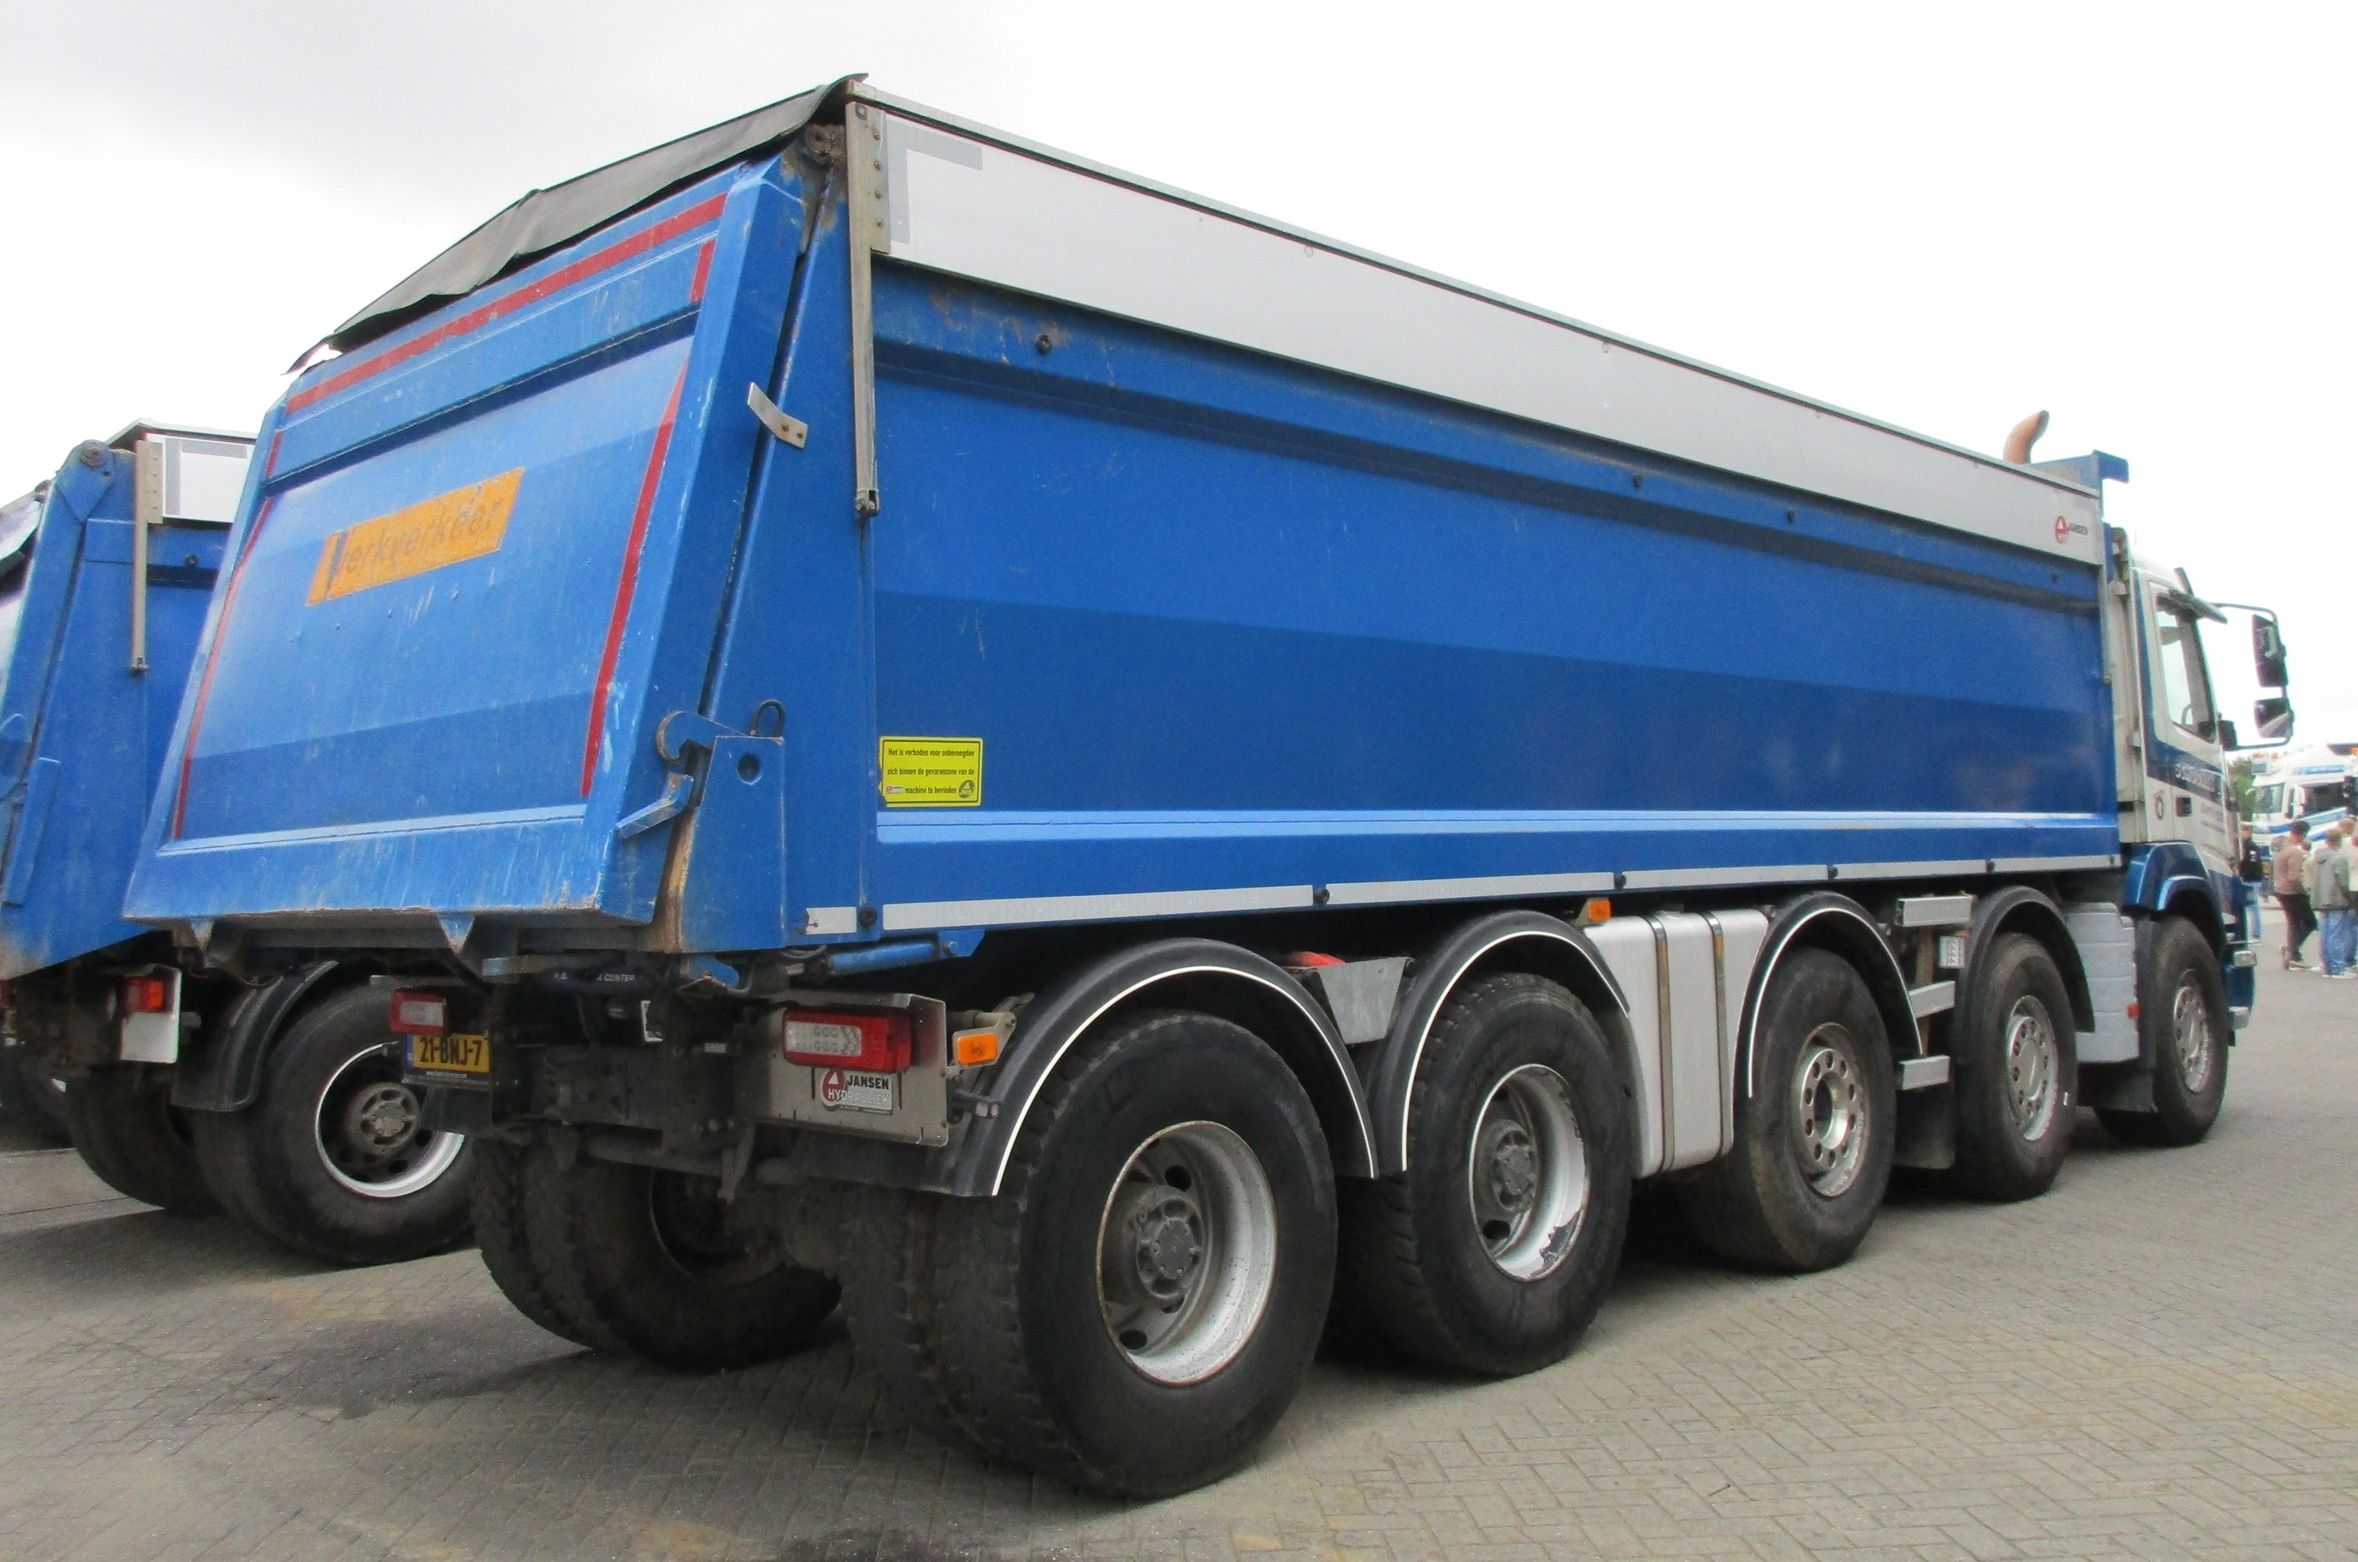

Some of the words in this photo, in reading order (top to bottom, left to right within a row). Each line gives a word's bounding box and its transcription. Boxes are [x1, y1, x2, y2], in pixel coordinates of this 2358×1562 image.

[888, 748, 898, 756] Het
[905, 749, 928, 757] verboden
[942, 749, 975, 758] onbevoegden
[968, 767, 975, 775] de
[847, 1075, 889, 1089] JANSEN
